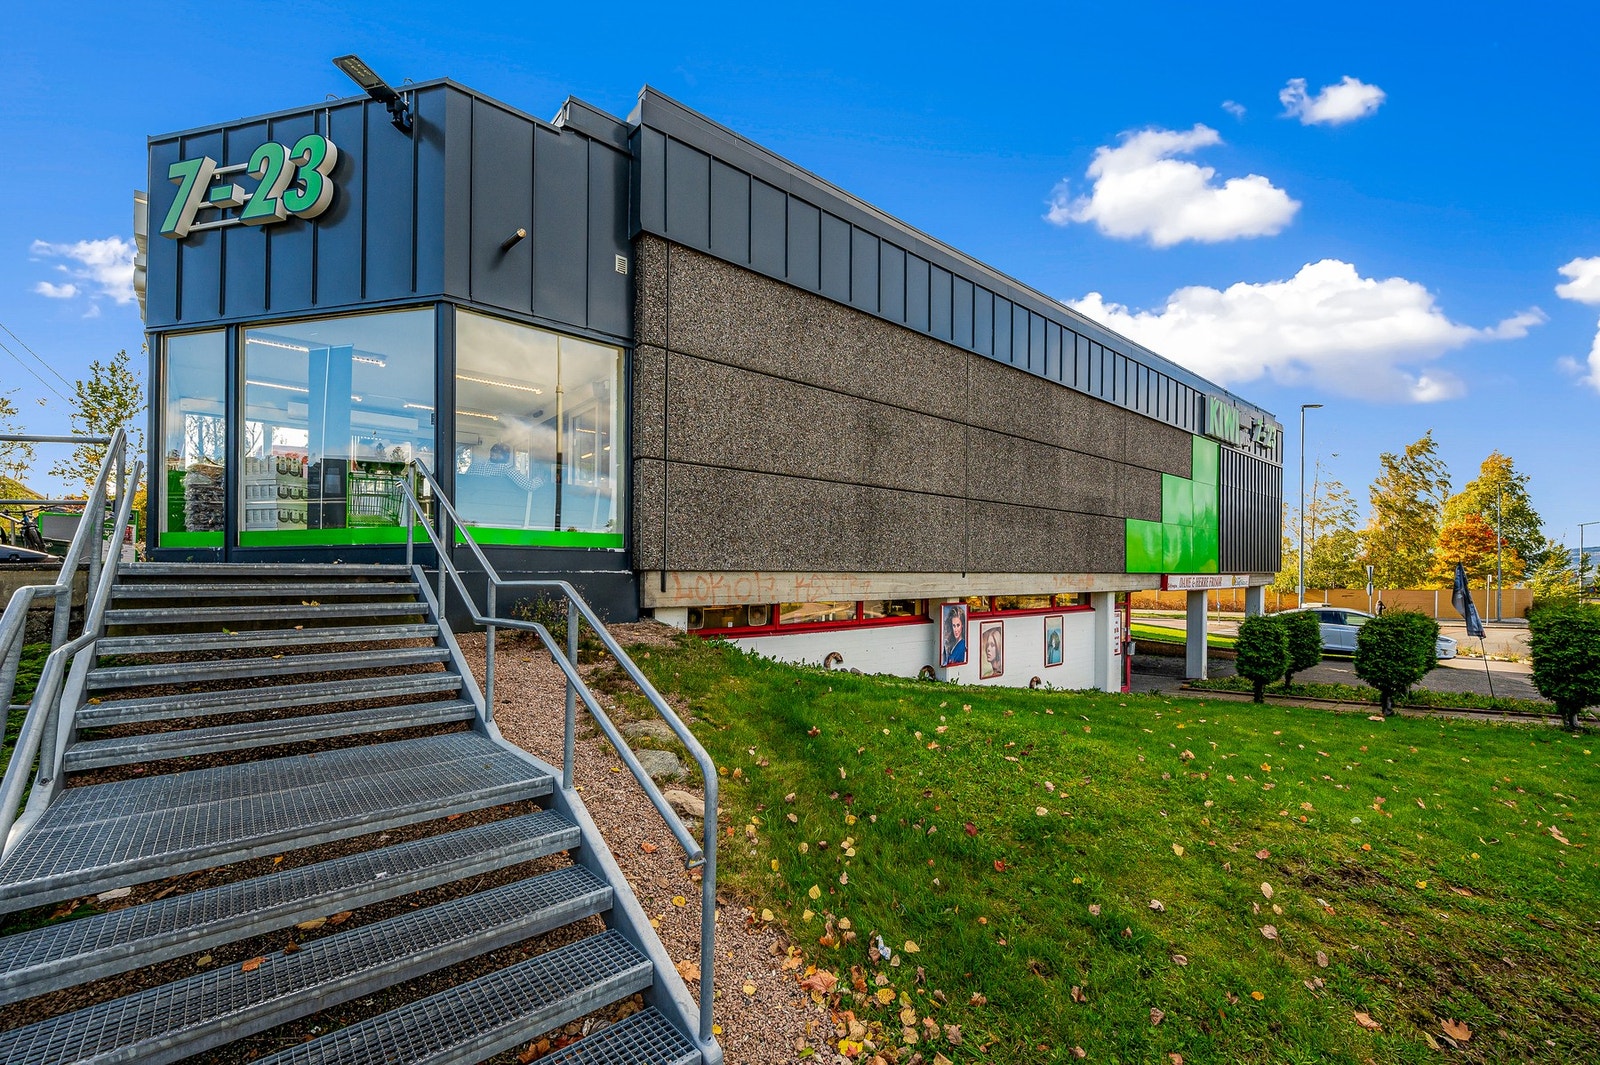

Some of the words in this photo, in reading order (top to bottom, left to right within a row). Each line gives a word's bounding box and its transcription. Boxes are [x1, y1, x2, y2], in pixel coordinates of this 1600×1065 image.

[160, 133, 336, 238] 7-23
[1209, 396, 1241, 446] KIWI
[1254, 418, 1277, 449] 7-23
